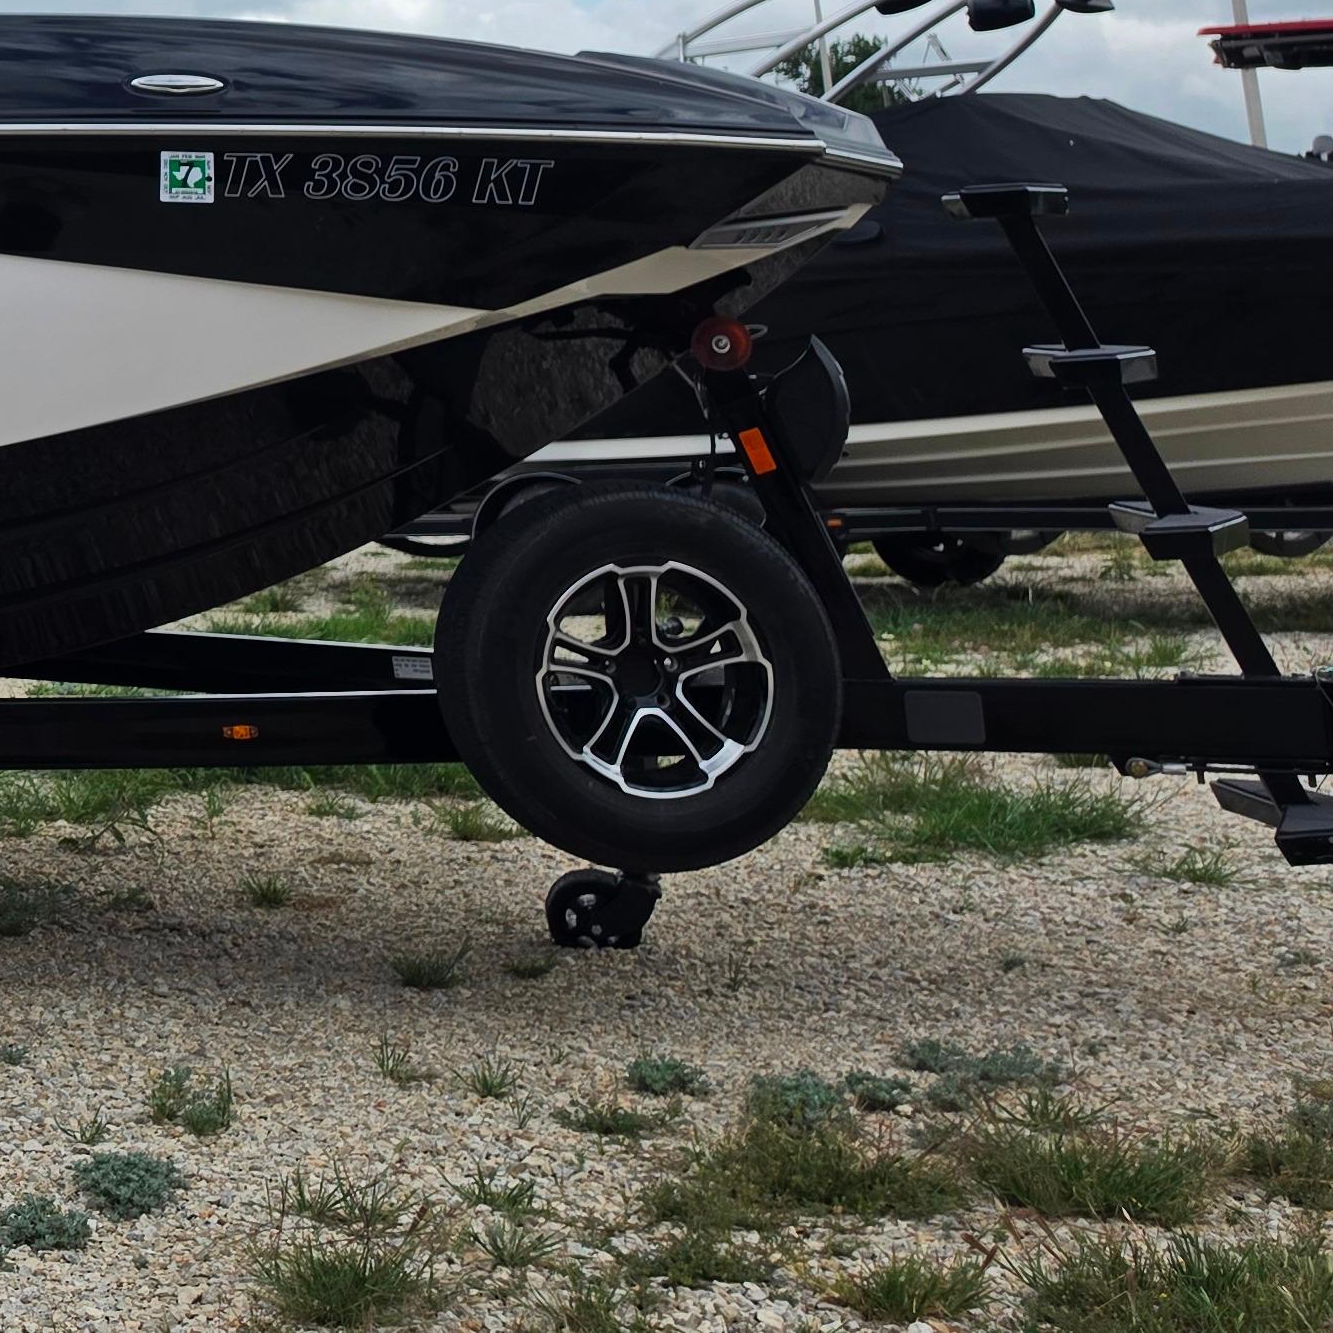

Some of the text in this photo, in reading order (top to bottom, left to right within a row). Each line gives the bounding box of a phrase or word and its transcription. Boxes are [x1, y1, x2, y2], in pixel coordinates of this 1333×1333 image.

[223, 153, 293, 198] TX
[303, 153, 459, 203] 3856
[472, 158, 555, 205] KT
